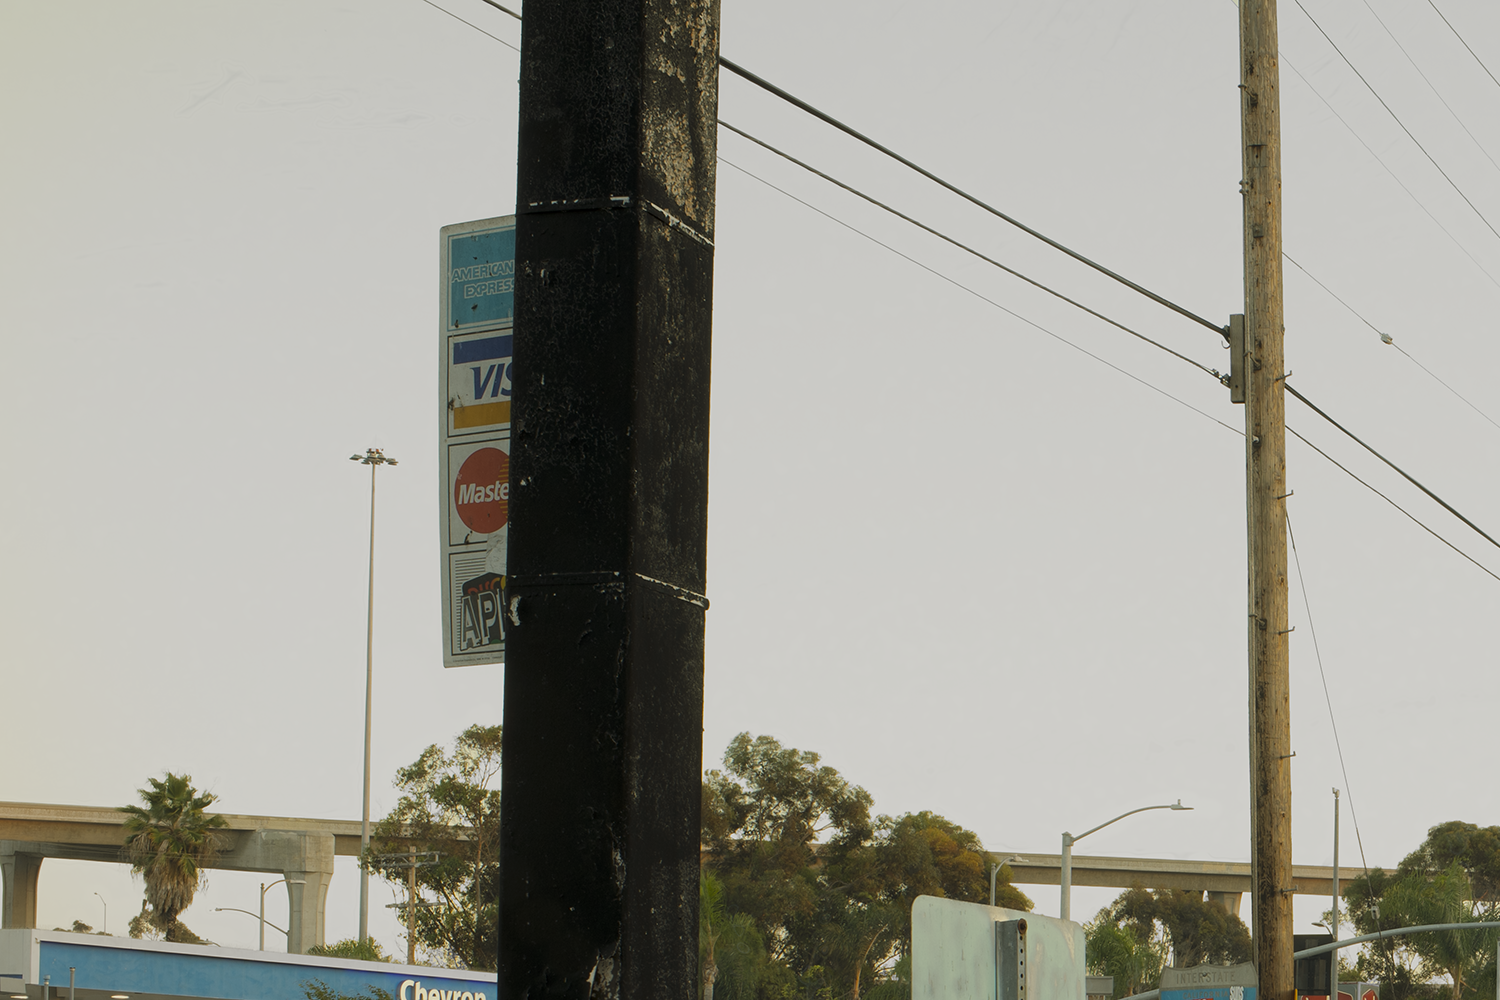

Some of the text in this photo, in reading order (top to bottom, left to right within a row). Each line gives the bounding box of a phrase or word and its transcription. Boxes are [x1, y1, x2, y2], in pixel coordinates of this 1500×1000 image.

[450, 263, 515, 284] AMERICAN
[1176, 971, 1236, 985] INTERSTATE
[1183, 990, 1229, 1000] CALIFORNIA
